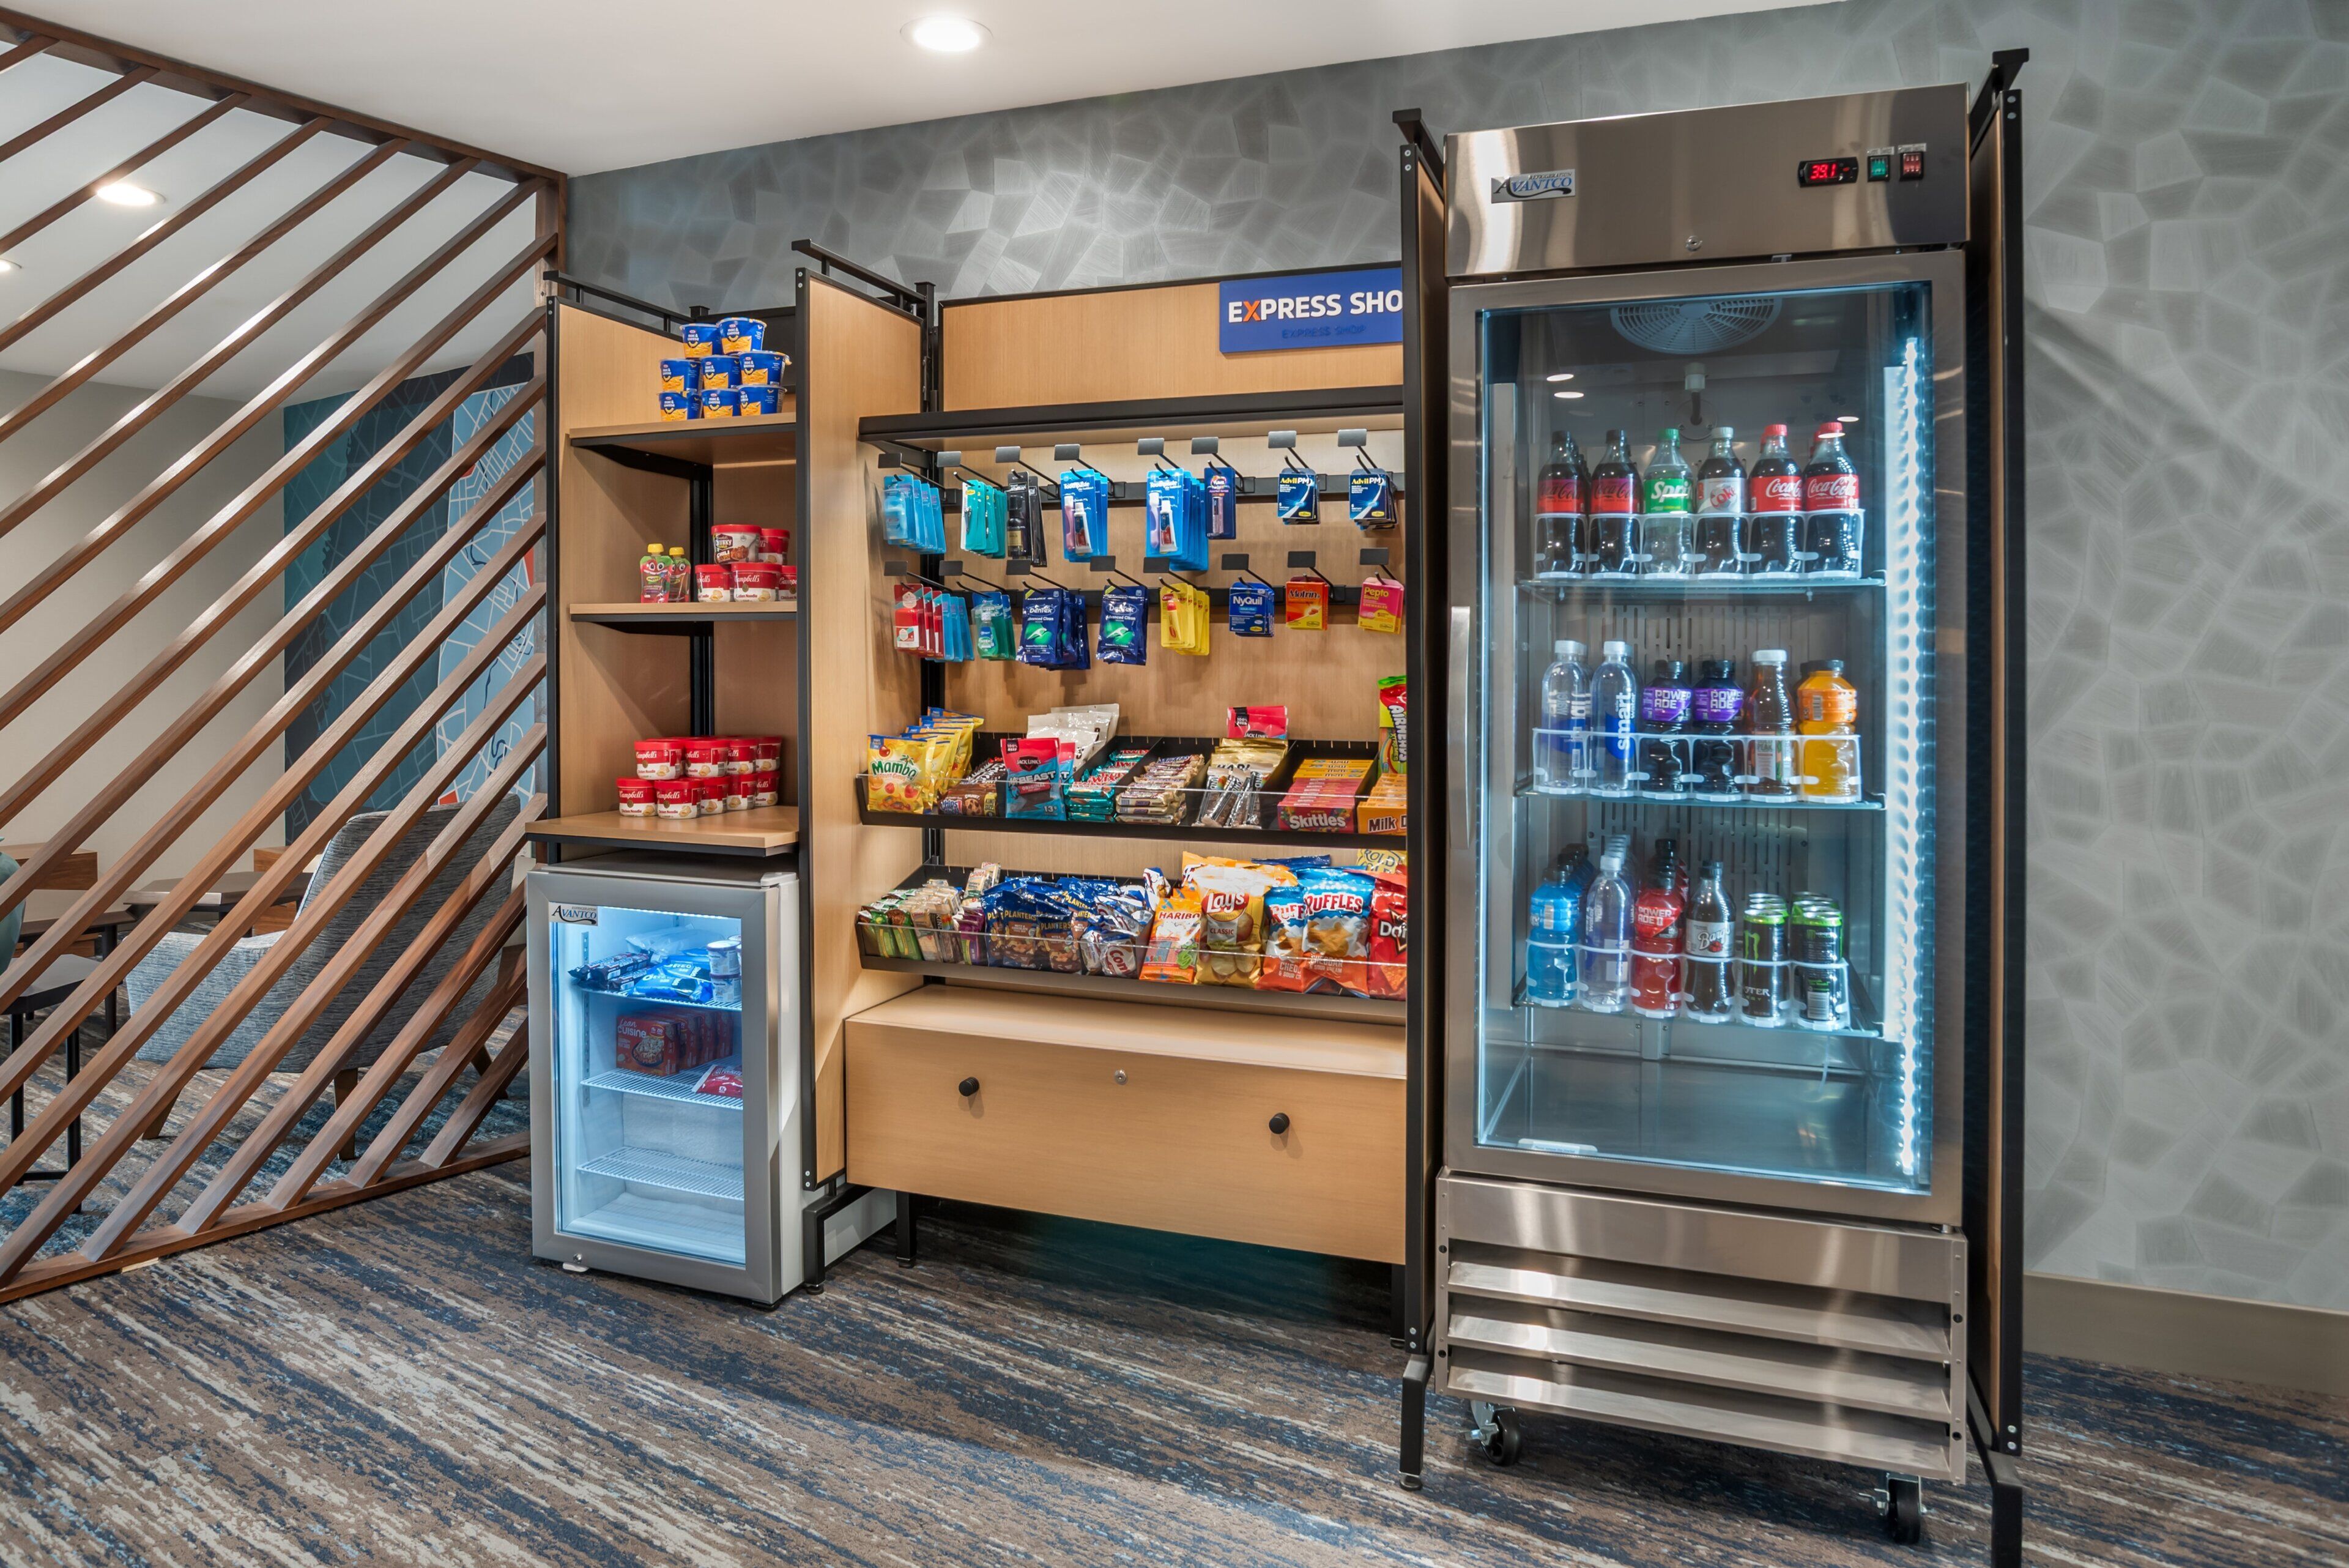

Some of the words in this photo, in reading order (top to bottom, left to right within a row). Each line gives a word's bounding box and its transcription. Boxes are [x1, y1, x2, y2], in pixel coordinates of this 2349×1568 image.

[1493, 176, 1572, 195] AVANTCO
[1228, 293, 1342, 323] EXPRESS
[1349, 289, 1403, 315] SHO
[1807, 476, 1855, 498] Coca-Co
[1288, 589, 1318, 598] Motrin
[1364, 587, 1389, 597] Pepto
[1233, 595, 1263, 606] NyQuil
[1655, 689, 1691, 700] POWER
[1654, 699, 1678, 709] ADE
[1710, 699, 1734, 709] ADE
[1617, 692, 1631, 750] smart
[870, 760, 918, 781] Mamba
[1289, 812, 1346, 829] Skittles
[1368, 816, 1397, 833] Milk
[1364, 849, 1395, 868] ROLD
[1304, 894, 1363, 915] RUFFLES
[552, 905, 597, 921] AVANTCO
[1004, 910, 1037, 921] PLANTERS
[1159, 911, 1201, 920] HARIBO
[1638, 905, 1672, 917] POWER
[1638, 914, 1655, 924] ADE
[1041, 922, 1071, 931] PLANTERS
[1308, 955, 1343, 968] CHEDDAR
[619, 1017, 637, 1028] Lean
